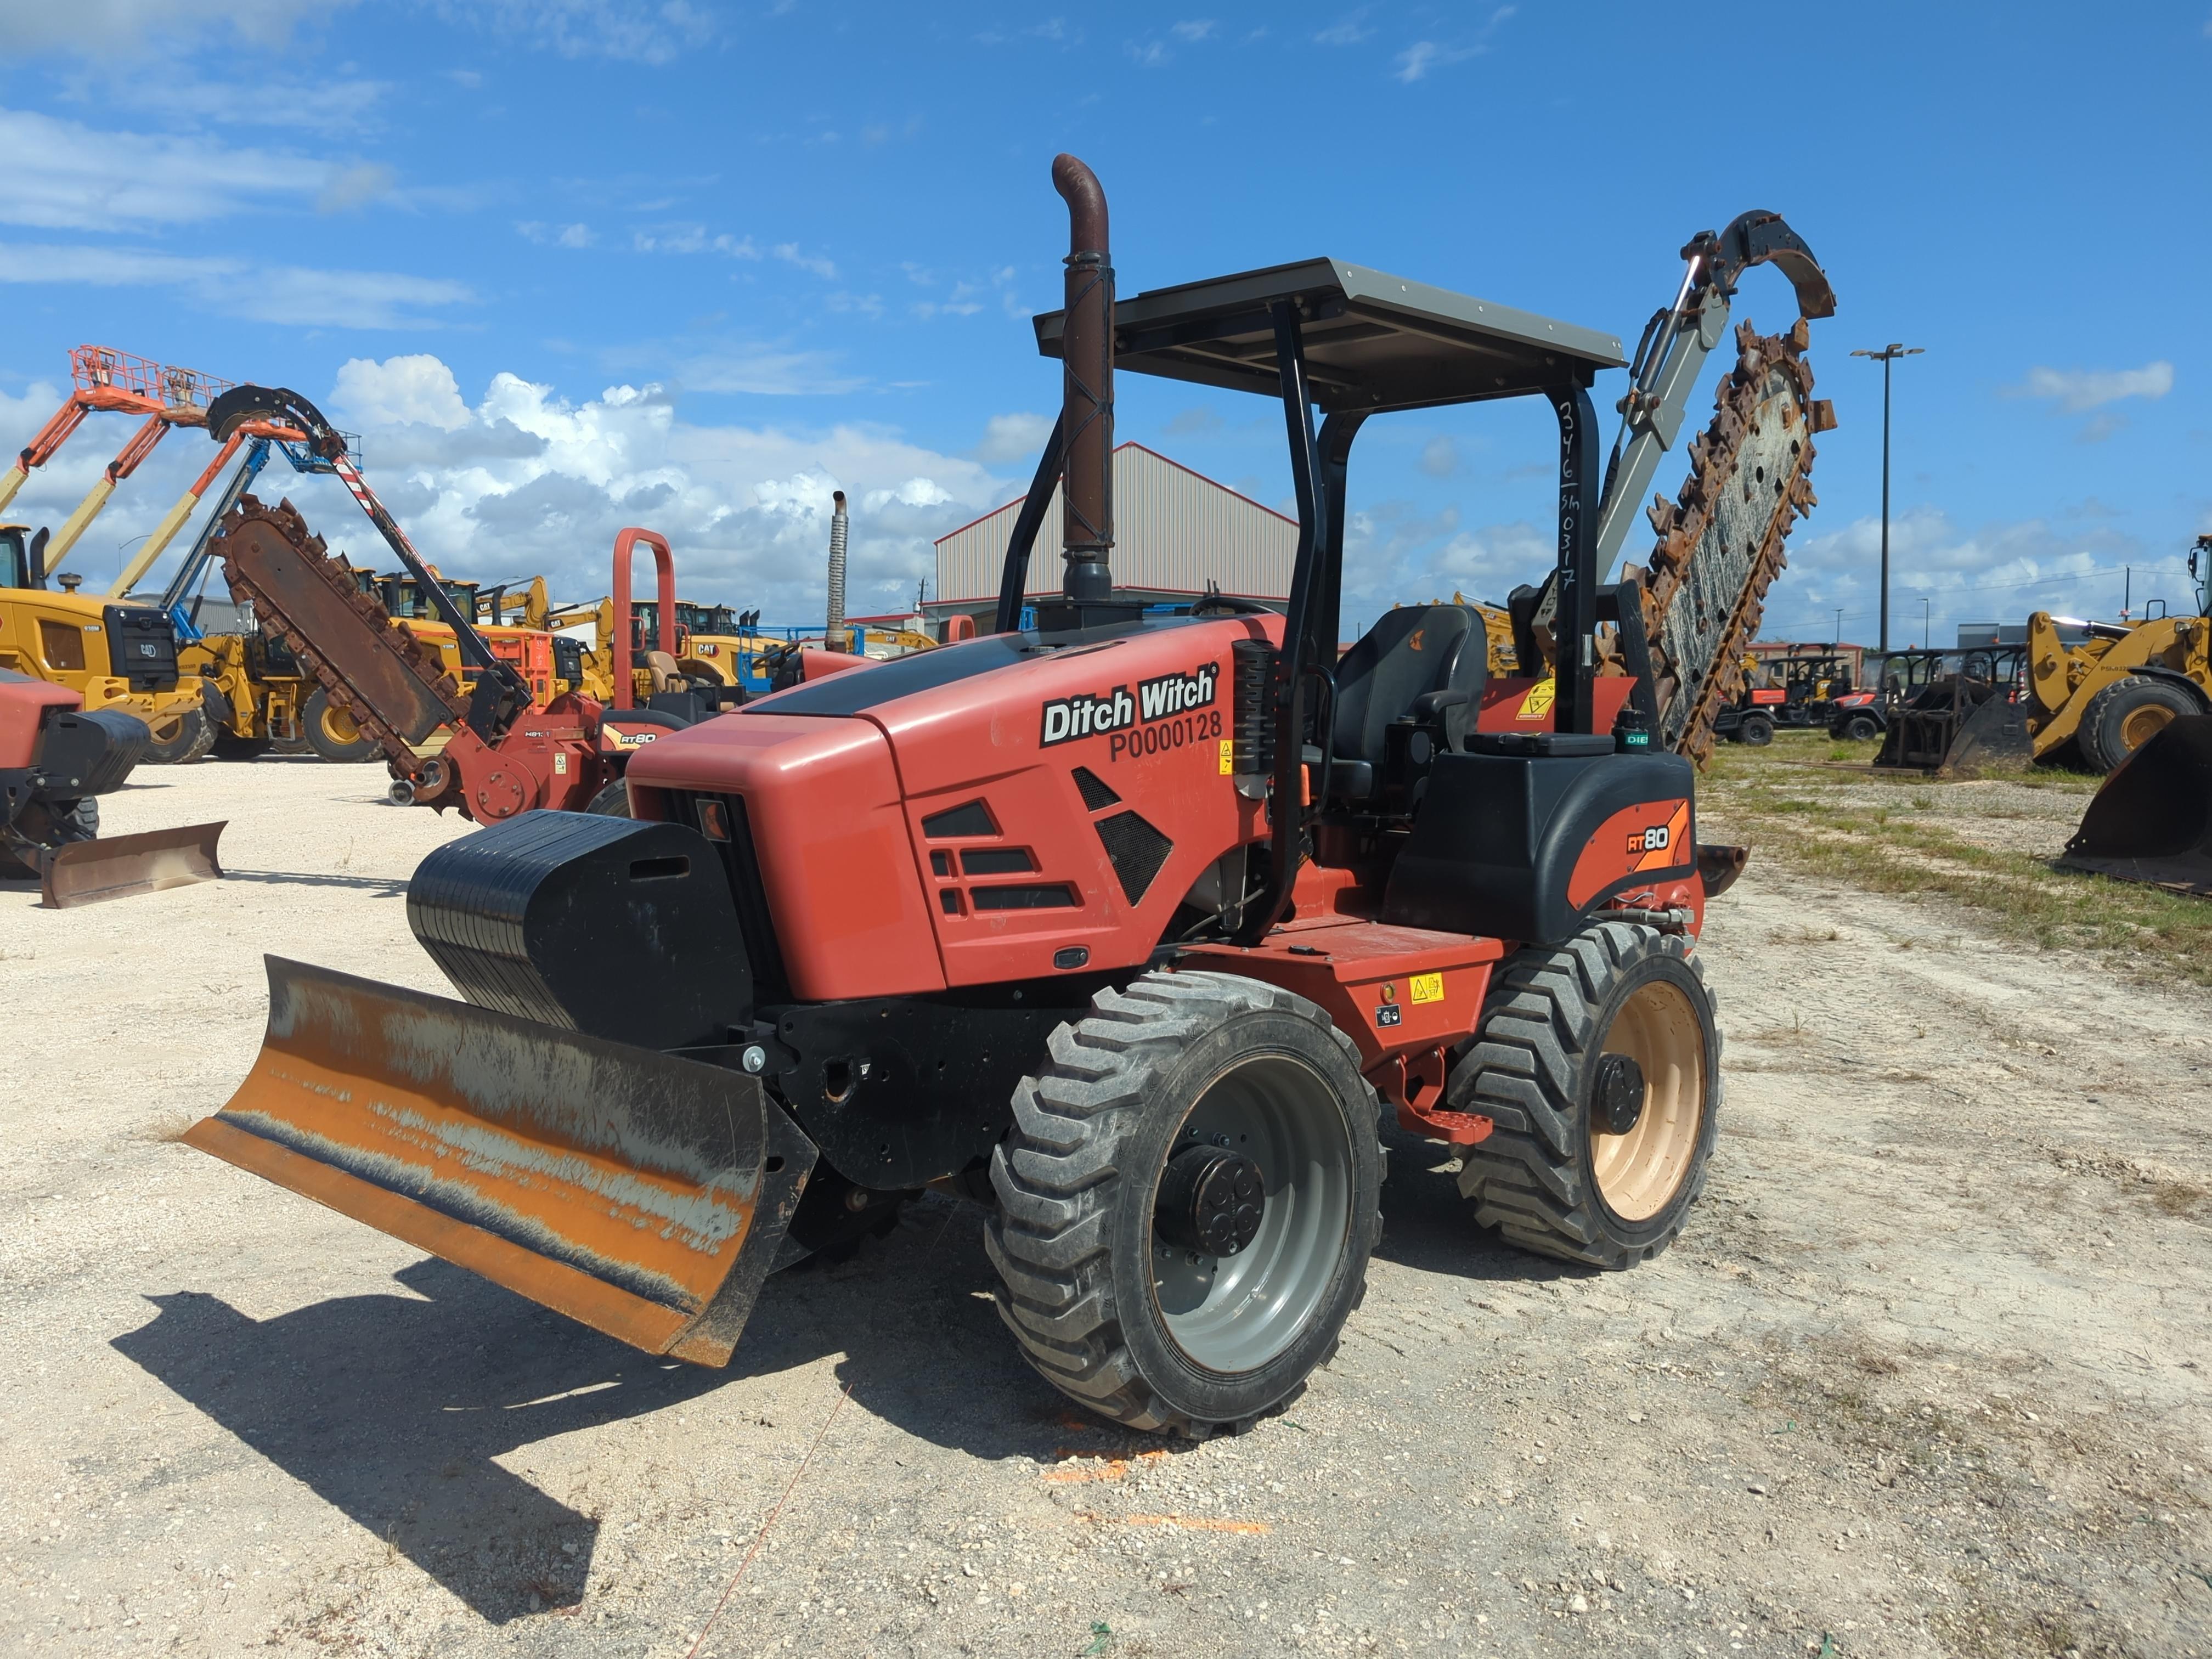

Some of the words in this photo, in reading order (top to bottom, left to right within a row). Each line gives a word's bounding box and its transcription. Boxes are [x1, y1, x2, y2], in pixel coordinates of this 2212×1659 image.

[479, 602, 491, 612] CAT
[550, 619, 561, 628] CAT
[697, 644, 715, 655] CAT
[1044, 691, 1132, 743] Ditch
[1141, 670, 1214, 720] Witch
[1110, 710, 1223, 763] P0000128
